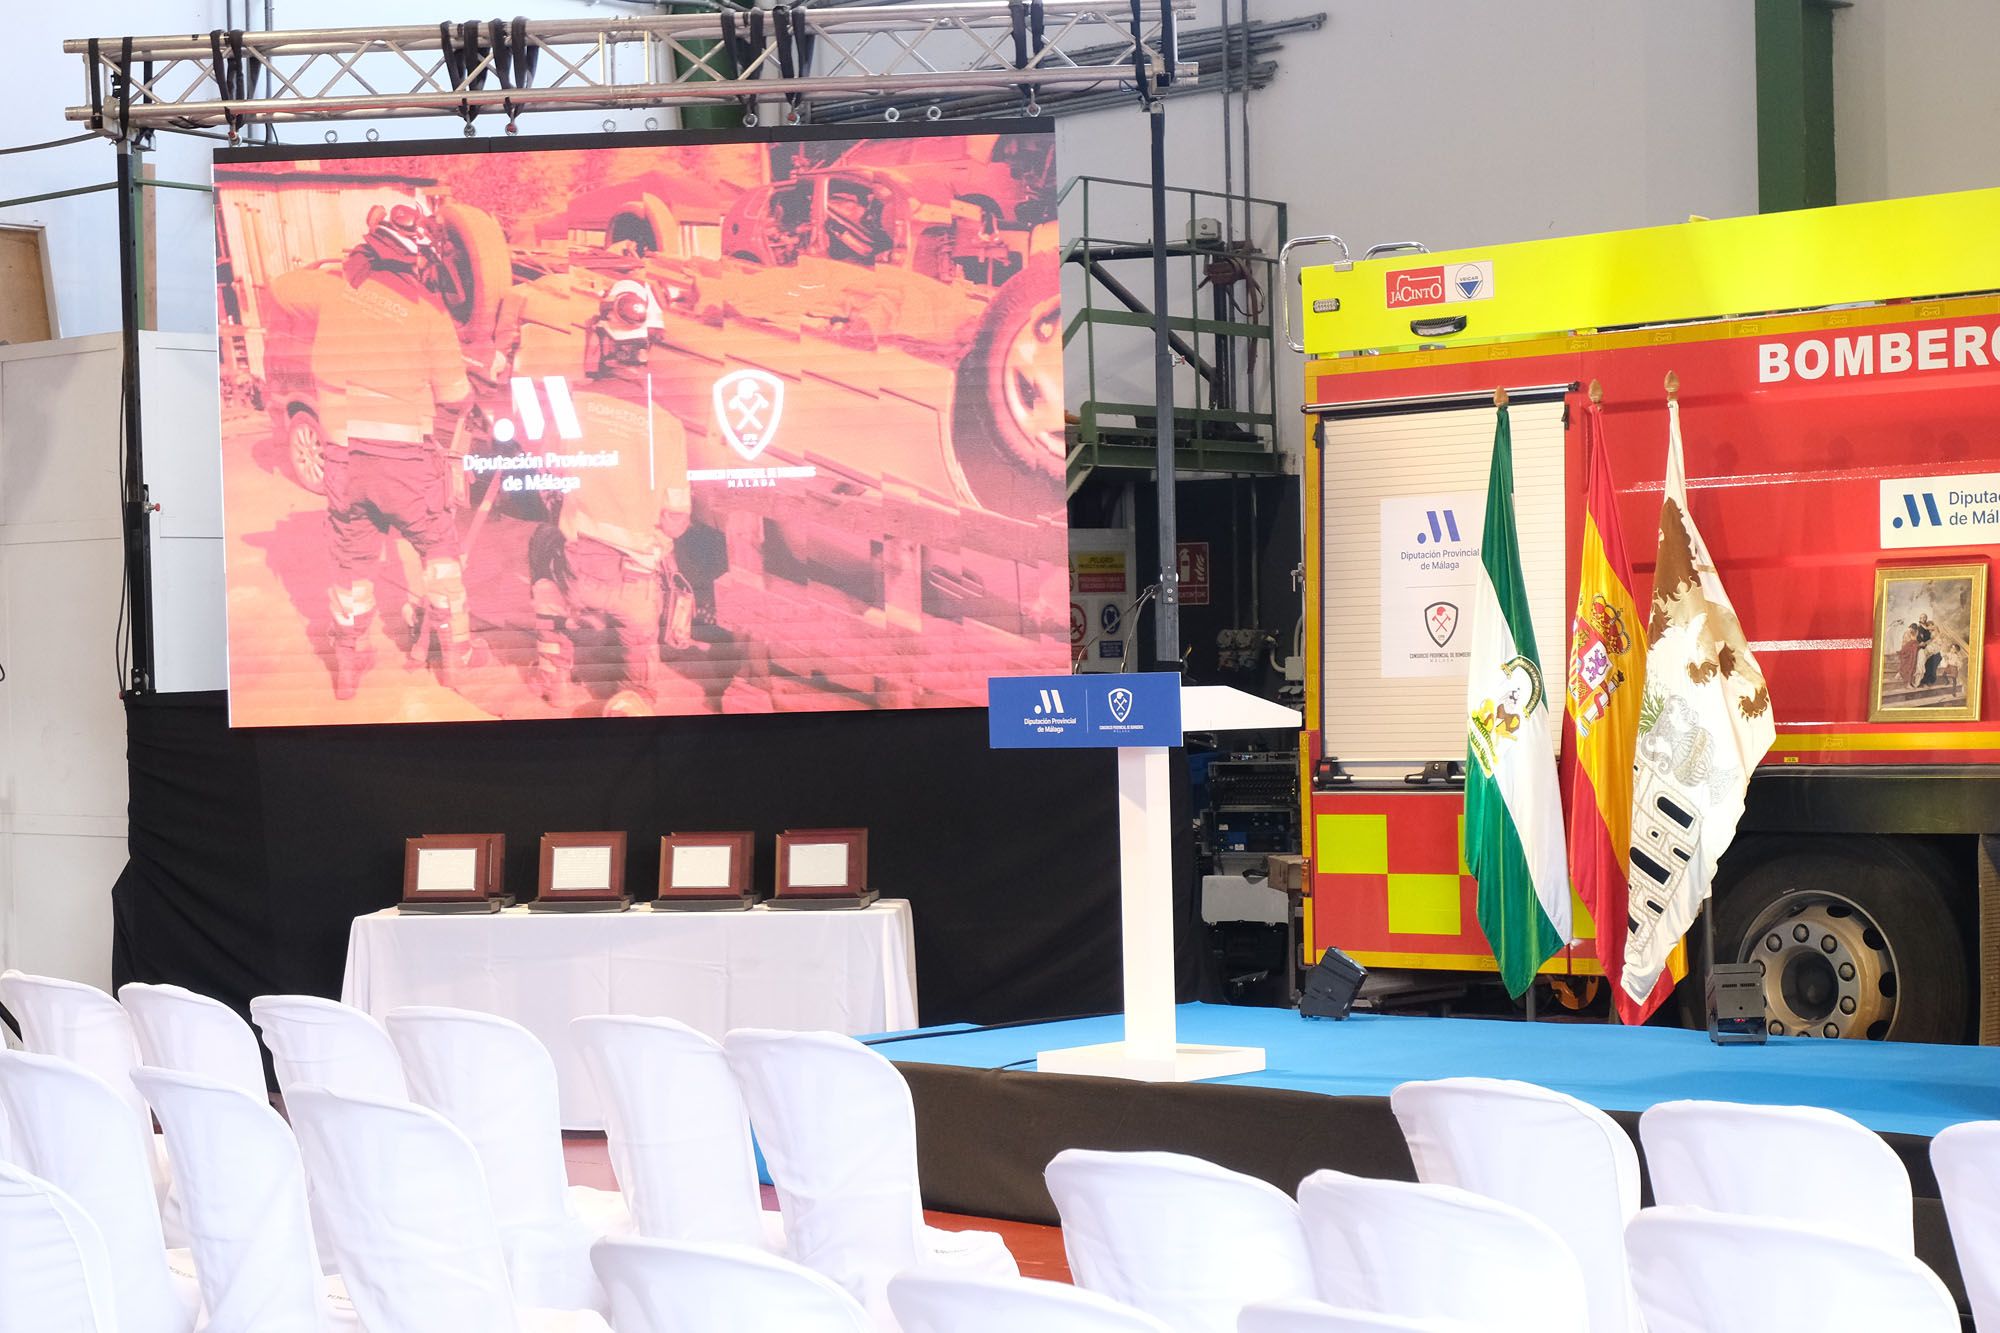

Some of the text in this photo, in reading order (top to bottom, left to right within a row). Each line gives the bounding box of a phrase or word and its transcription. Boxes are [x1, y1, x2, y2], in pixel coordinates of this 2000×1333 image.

[1390, 283, 1442, 304] JACINTO
[1758, 325, 2000, 383] BOMBER
[463, 450, 620, 474] Diputación Provincial
[502, 473, 581, 493] de Málaga
[1949, 511, 1968, 526] de
[1400, 547, 1480, 561] Diputación Provincial
[1420, 561, 1460, 571] de Málaga
[1024, 717, 1051, 727] Diputación
